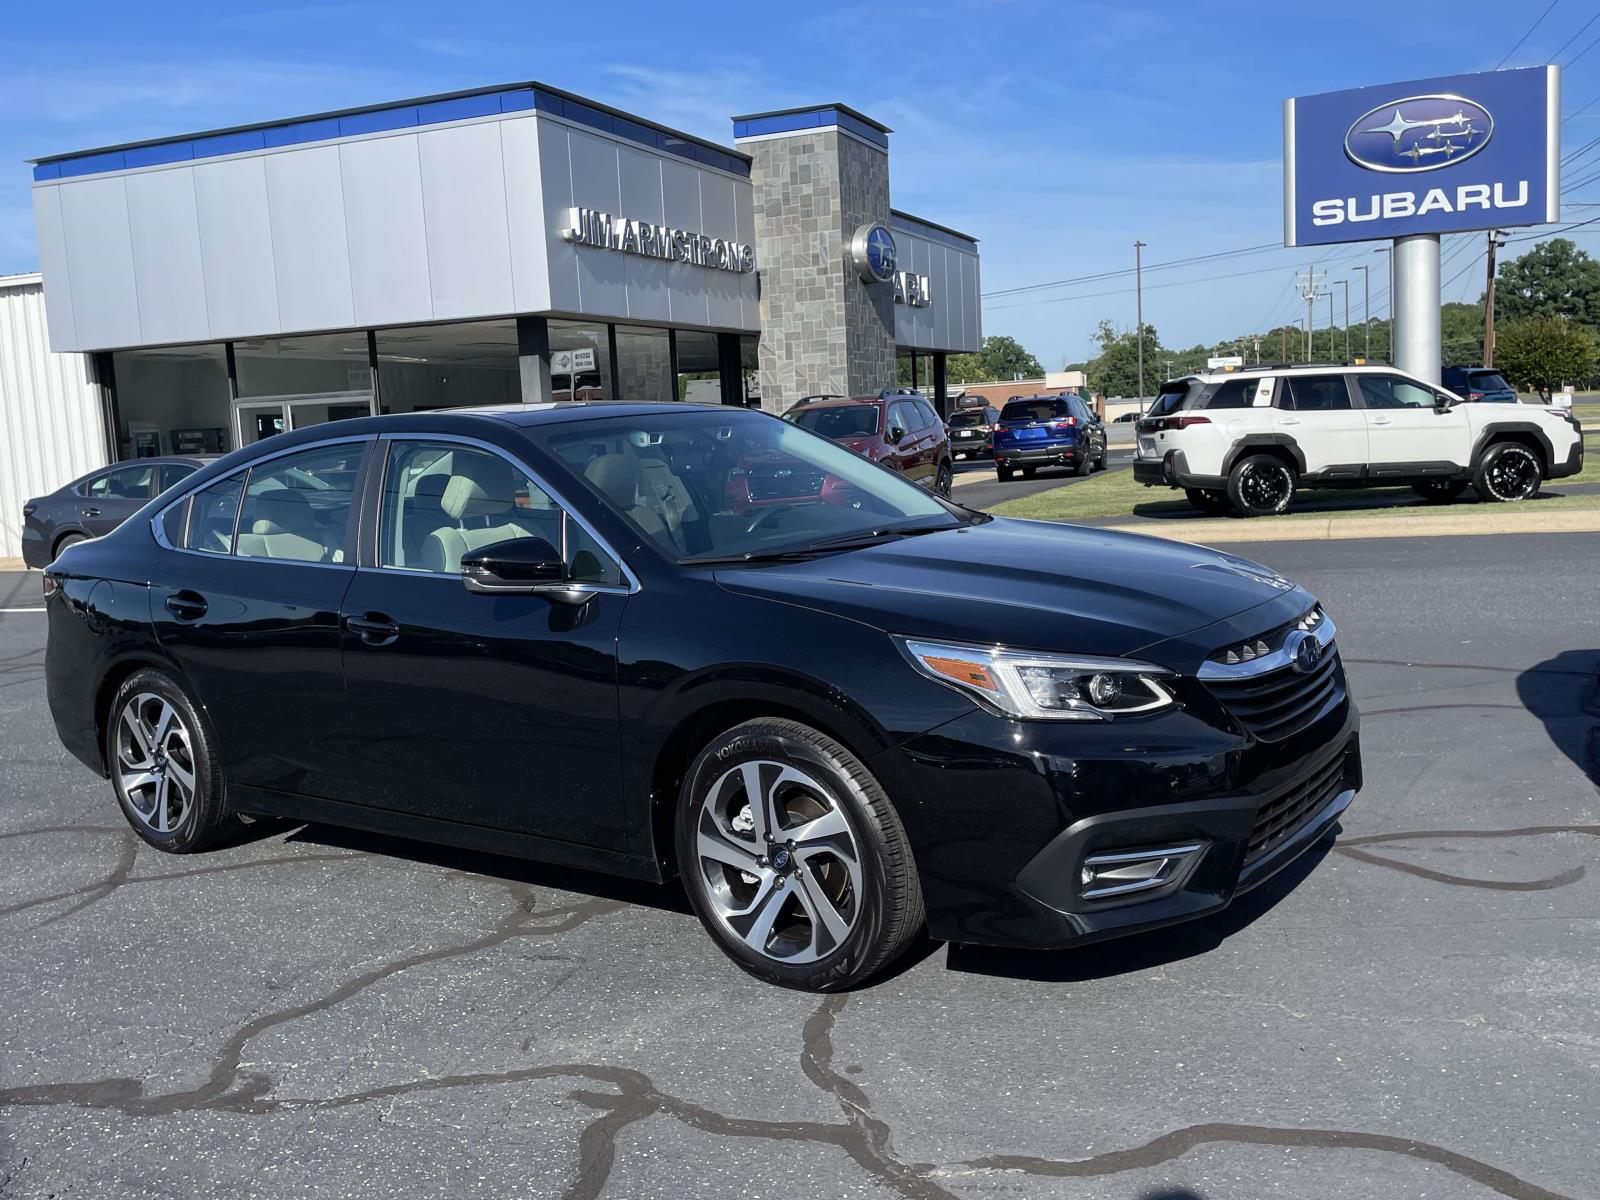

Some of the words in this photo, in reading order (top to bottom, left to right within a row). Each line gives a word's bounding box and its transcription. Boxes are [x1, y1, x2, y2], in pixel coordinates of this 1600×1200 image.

[1312, 180, 1528, 226] SUBARU
[563, 207, 614, 249] JIM
[616, 218, 756, 274] ARMSTRONG
